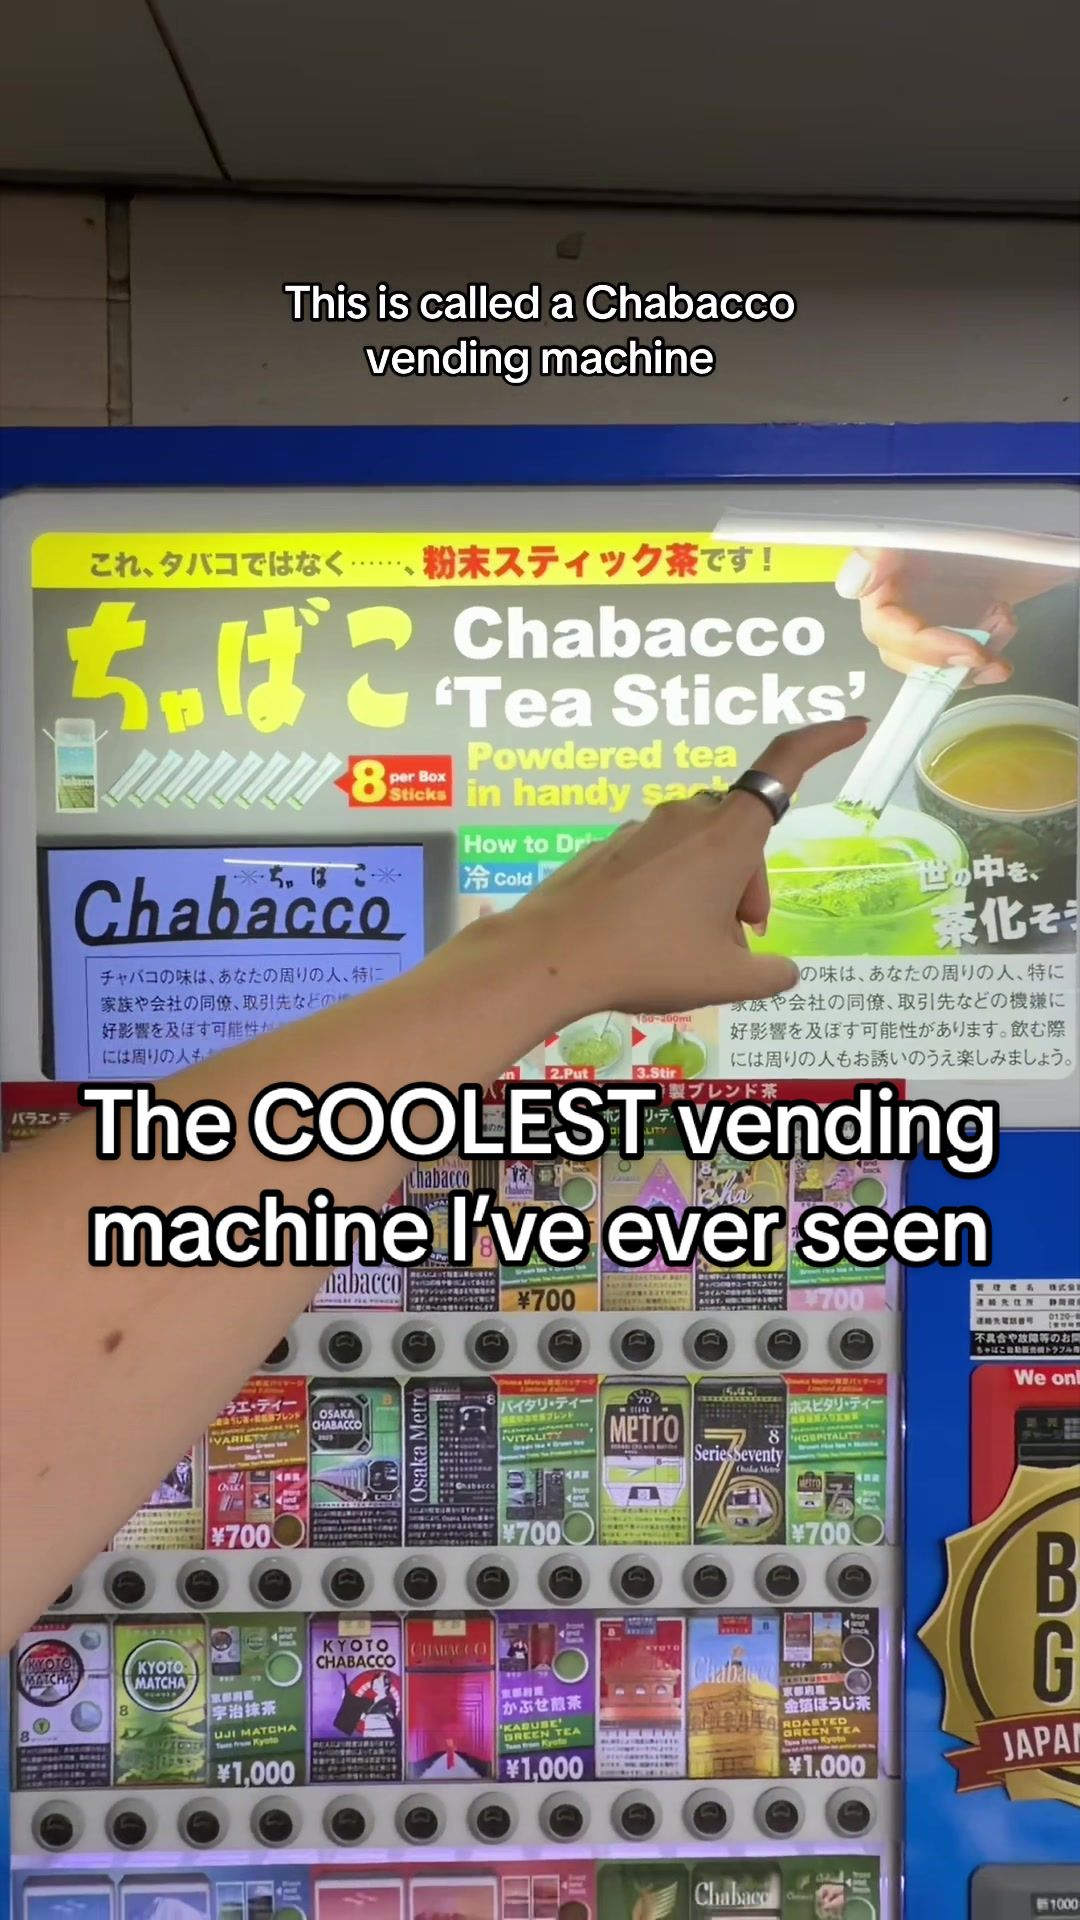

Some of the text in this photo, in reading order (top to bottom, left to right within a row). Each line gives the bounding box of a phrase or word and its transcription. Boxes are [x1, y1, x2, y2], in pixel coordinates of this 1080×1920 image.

[453, 606, 825, 660] Chabacco
[66, 597, 412, 733] ちゃばこ
[467, 740, 737, 771] Powdered tea
[352, 759, 387, 803] 8
[389, 770, 446, 784] per Box
[389, 787, 447, 801] Sticks
[467, 777, 630, 813] in handy
[464, 834, 602, 855] How to Dri
[269, 863, 366, 888] ちゃばこ
[464, 864, 532, 890] 冷 Cold
[919, 854, 1039, 893] 世の中を、
[75, 876, 406, 946] Chabacco
[800, 963, 1065, 982] の味は、あなたの周りの人、特に
[101, 994, 350, 1013] 家族や会社の同僚、取引先などの
[550, 1067, 589, 1080] 2.Put
[636, 1066, 676, 1080] 3.Stir
[701, 1162, 712, 1176] 8
[480, 1235, 492, 1257] 8
[325, 1265, 401, 1294] habacco
[518, 1289, 576, 1311] ¥700
[804, 1289, 864, 1310] ¥700
[1014, 1369, 1046, 1386] We
[218, 1399, 297, 1416] ラエ・ティー
[319, 1409, 354, 1419] OSAKA
[312, 1420, 362, 1430] CHABACCO
[409, 1388, 428, 1503] Osaka Metro
[768, 1429, 780, 1444] 8
[211, 1524, 271, 1549] ¥700
[502, 1521, 560, 1545] ¥700
[792, 1521, 850, 1545] ¥700
[323, 1639, 388, 1653] KYOTO
[410, 1641, 487, 1658] CHABACCO
[29, 1657, 72, 1670] KYOTO
[138, 1660, 184, 1675] KYOTO
[316, 1654, 396, 1668] CHABACCO
[25, 1673, 74, 1687] MATCHA
[135, 1676, 186, 1690] MATCHA
[120, 1704, 129, 1716] 8
[212, 1700, 277, 1720] 宇治抹茶
[503, 1695, 582, 1716] かぶせ煎茶
[784, 1695, 871, 1714] 金箔ほうじ茶
[215, 1724, 297, 1740] UJI MATCHA
[783, 1717, 847, 1729] ROASTED
[783, 1726, 861, 1738] GREEN TEA
[20, 1731, 30, 1743] 8
[253, 1736, 279, 1747] Kyoto
[504, 1727, 582, 1742] GREEN TEA
[541, 1738, 567, 1748] Kyoto
[821, 1735, 846, 1744] Kyoto
[217, 1760, 296, 1787] ¥1,000
[506, 1755, 584, 1784] ¥1,000
[789, 1754, 866, 1779] ¥1,000
